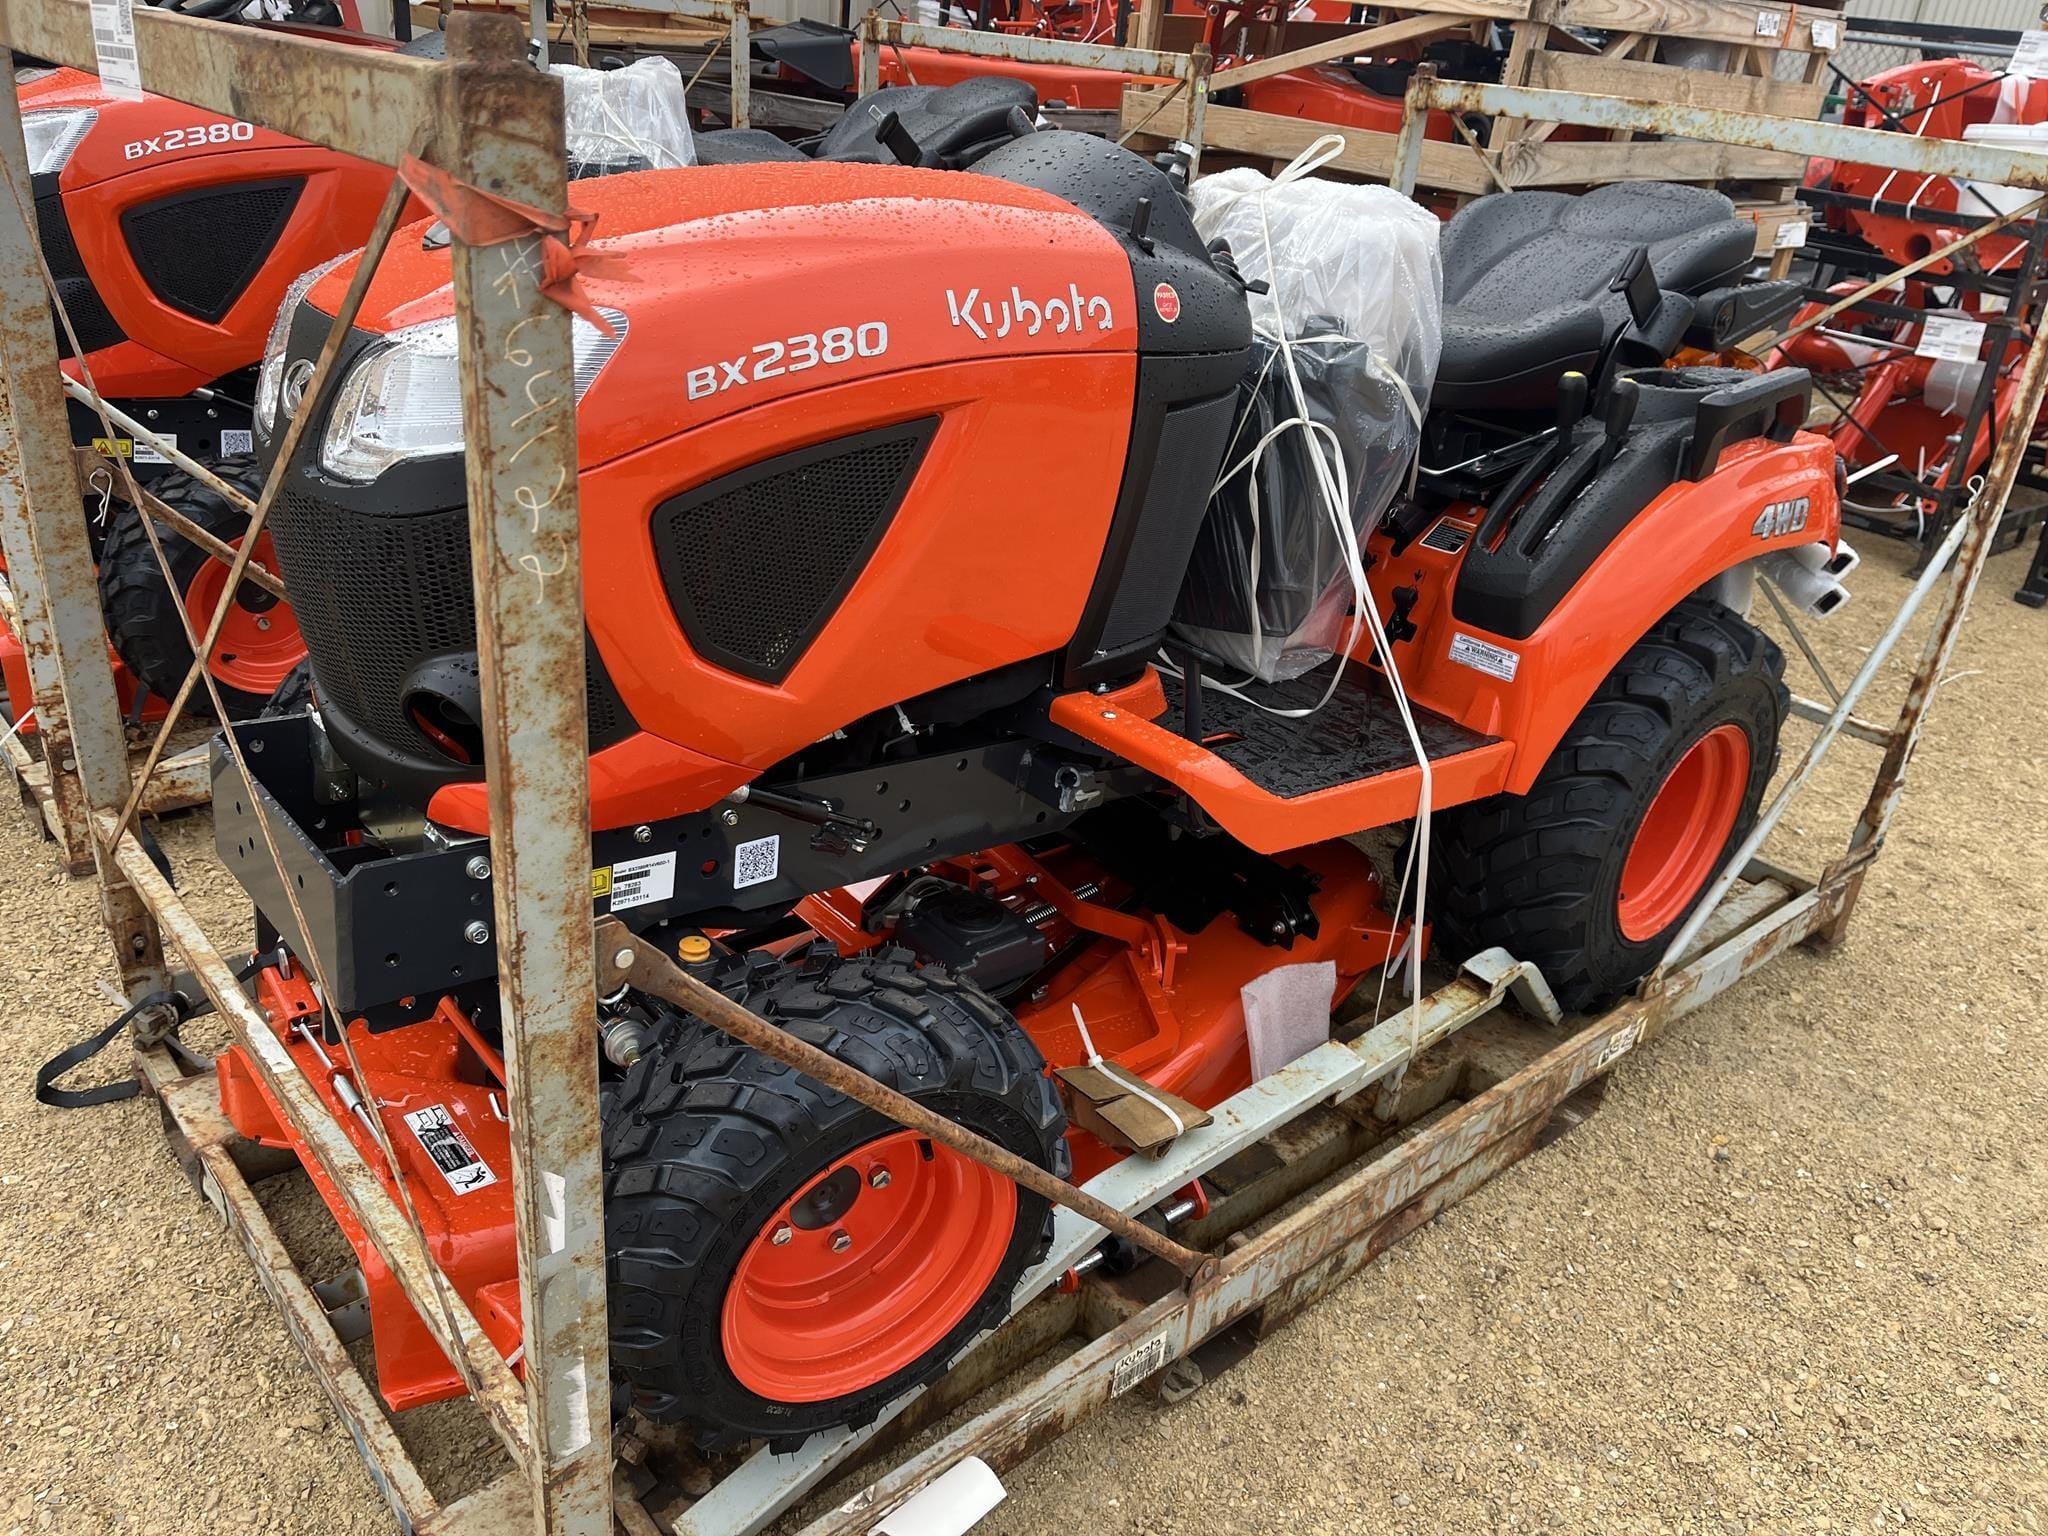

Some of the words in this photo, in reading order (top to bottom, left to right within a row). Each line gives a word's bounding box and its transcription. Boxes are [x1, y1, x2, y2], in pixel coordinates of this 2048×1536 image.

[124, 121, 254, 160] BX2380
[945, 283, 1113, 340] Kubota
[686, 321, 889, 401] BX2380
[1751, 496, 1811, 539] 4WD
[1471, 645, 1498, 662] WARNING
[457, 1135, 476, 1157] DANGER
[1120, 1338, 1162, 1368] Kubota
